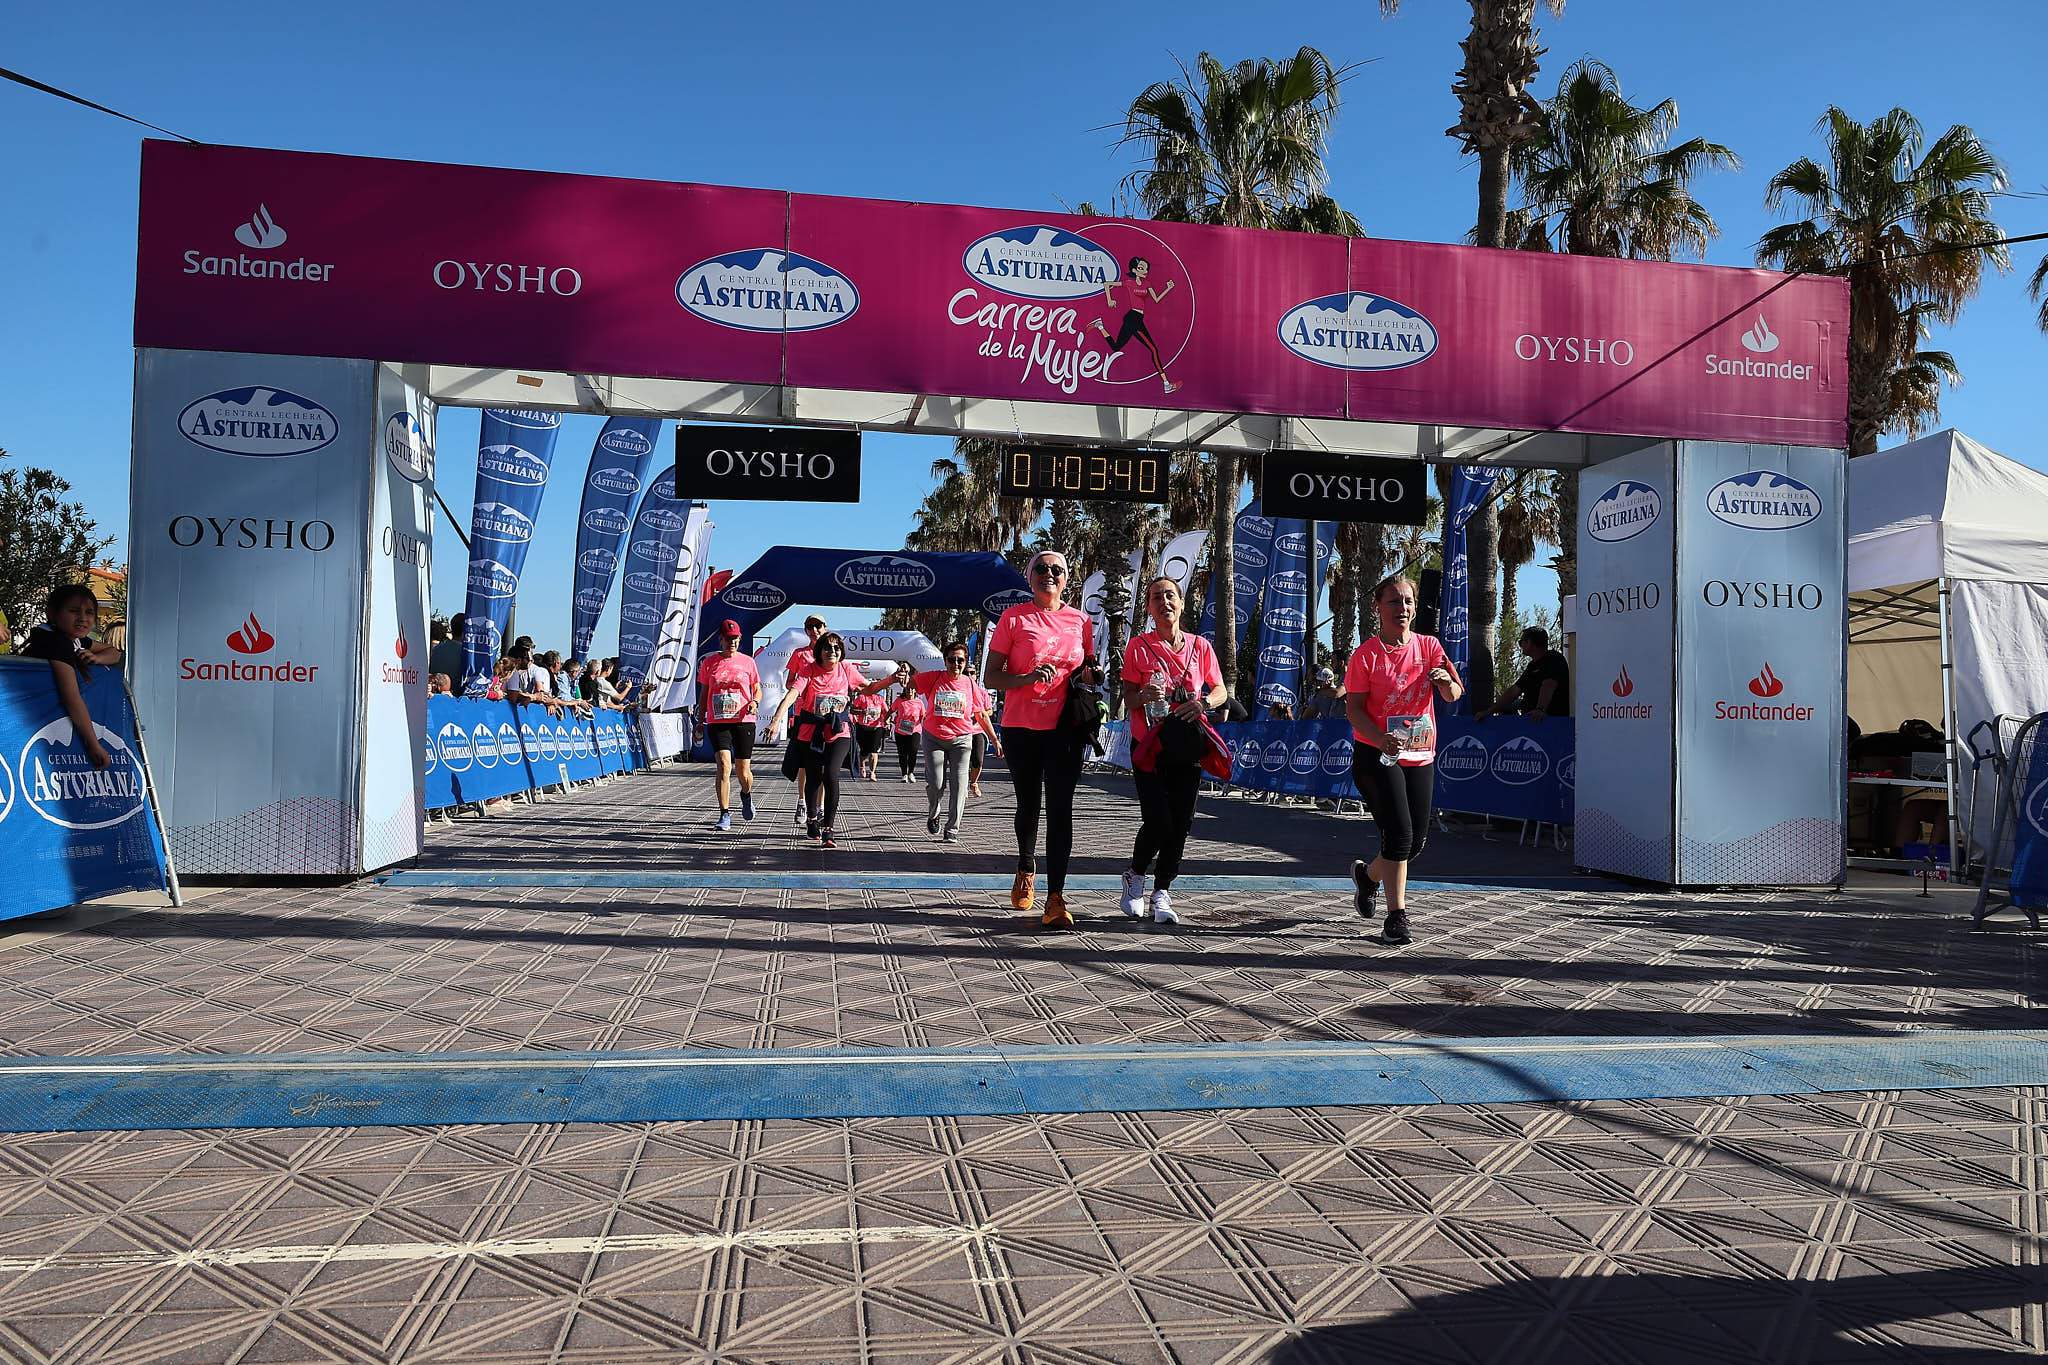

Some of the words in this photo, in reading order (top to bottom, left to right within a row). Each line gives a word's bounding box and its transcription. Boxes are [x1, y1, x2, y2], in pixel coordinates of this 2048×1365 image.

[183, 250, 334, 282] Santander
[976, 247, 1107, 284] ASTURIANA
[1000, 247, 1049, 259] CENTRAL
[1054, 252, 1104, 263] LECHERA
[433, 260, 583, 297] OYSHO
[719, 273, 778, 287] CENTRAL
[781, 278, 840, 290] LECHERA
[691, 274, 845, 315] ASTURIANA
[948, 288, 1077, 335] Carrera
[1314, 316, 1366, 328] CENTRAL
[1369, 319, 1422, 330] LECHERA
[1289, 316, 1426, 354] ASTURIANA
[1514, 333, 1634, 366] OYSHO
[978, 331, 1003, 357] de
[1007, 332, 1025, 360] la
[1021, 333, 1124, 394] Mujer
[1705, 353, 1813, 381] Santander
[190, 409, 327, 441] ASTURIANA
[215, 408, 267, 418] CENTRAL
[271, 411, 322, 421] LECHERA
[706, 448, 836, 480] OYSHO
[1013, 453, 1157, 493] 01:03:40
[1289, 473, 1404, 503] OYSHO
[1732, 490, 1769, 499] CENTRAL
[1772, 492, 1809, 500] LECHERA
[1591, 502, 1655, 533] ASTURIANA
[1715, 491, 1812, 518] ASTURIANA
[168, 515, 335, 551] OYSHO
[382, 526, 427, 569] OYSHO
[843, 566, 928, 588] ASTURIANA
[726, 591, 781, 604] ASTURIANA
[1587, 582, 1660, 616] OYSHO
[1703, 580, 1823, 610] OYSHO
[180, 658, 319, 683] Santander
[382, 662, 420, 685] Santander
[1592, 702, 1653, 720] Santander
[1715, 701, 1814, 721] Santander
[48, 754, 88, 765] CENTRAL
